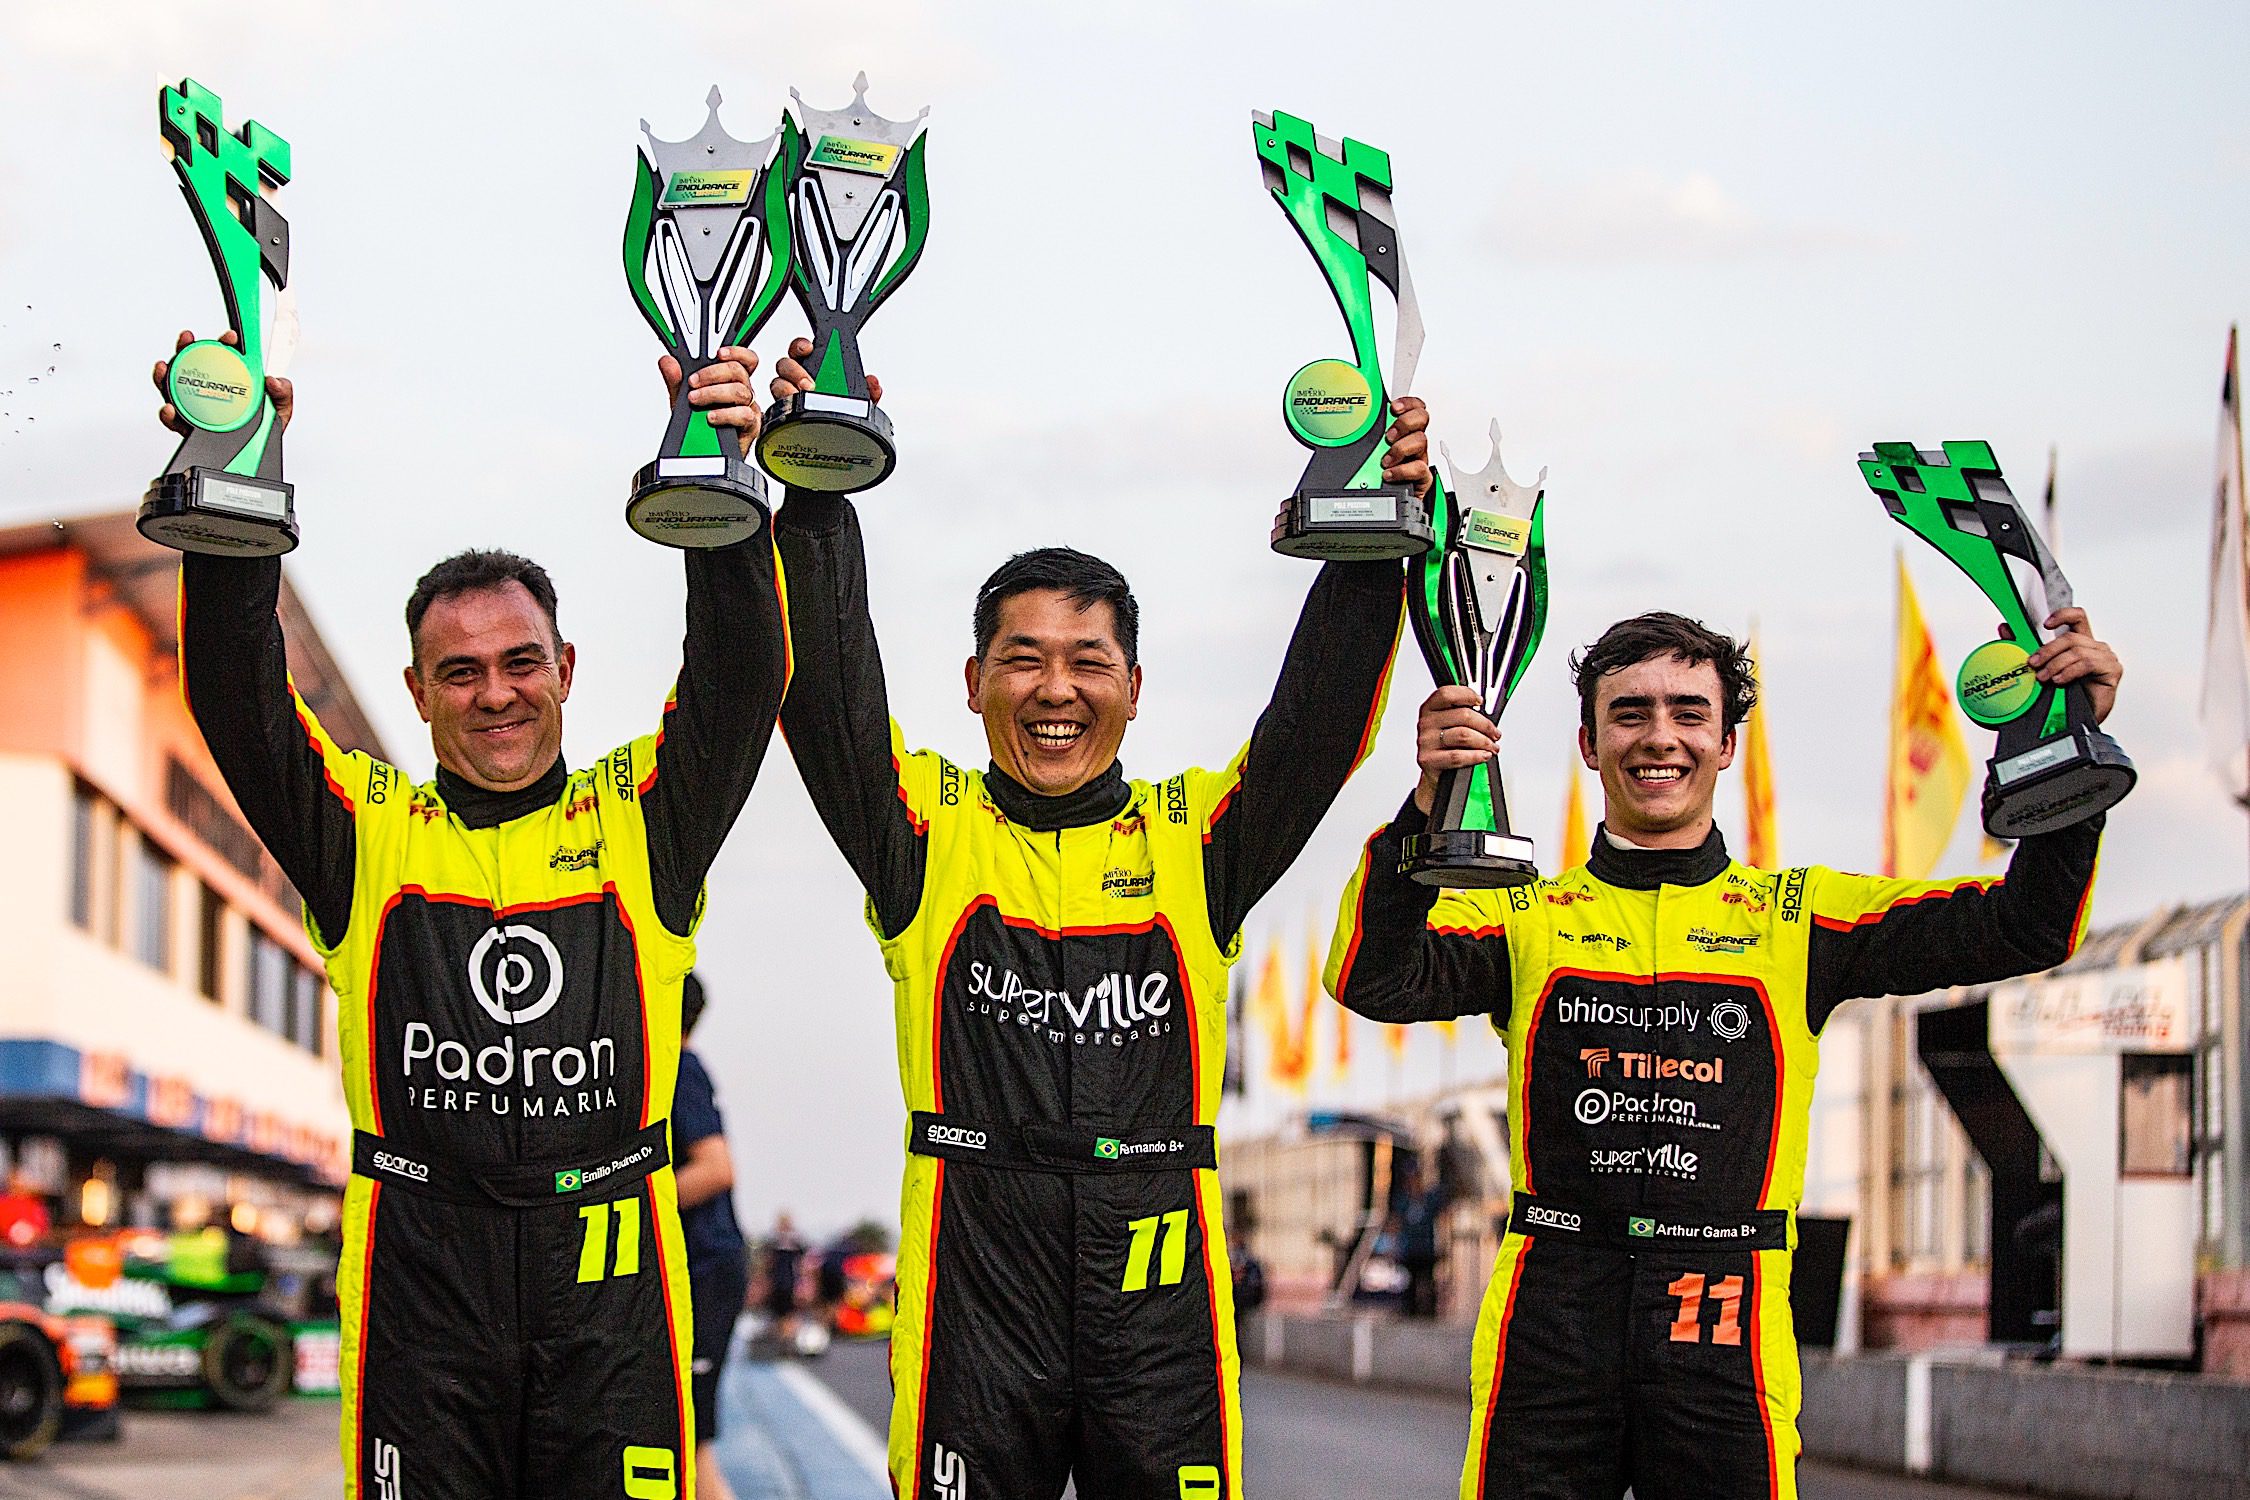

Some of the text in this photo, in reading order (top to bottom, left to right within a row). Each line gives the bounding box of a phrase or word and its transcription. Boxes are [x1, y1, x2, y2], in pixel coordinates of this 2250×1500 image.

[822, 147, 884, 161] ENDURANCE
[675, 183, 740, 191] ENDURANCE
[177, 376, 247, 395] ENDURANCE
[1293, 396, 1366, 406] ENDURANCE
[771, 450, 874, 466] ENDURANCE
[1474, 524, 1520, 540] ENDURANCE
[1964, 664, 2030, 697] ENDURANCE
[1558, 929, 1615, 944] MC PRATA
[1687, 934, 1758, 945] ENDURANCE
[967, 1001, 1170, 1046] supermercado
[404, 1022, 614, 1086] Padron
[408, 1087, 616, 1118] PERFUMARIA
[1612, 1092, 1696, 1117] Padron
[928, 1124, 1184, 1155] sparco Fernando B+
[373, 1151, 429, 1181] sparco
[582, 1166, 611, 1183] Emilio
[1526, 1205, 1757, 1238] sparco Arthur Gama B+
[577, 1197, 640, 1284] 11
[1121, 1209, 1189, 1292] 11
[1667, 1272, 1744, 1346] 11
